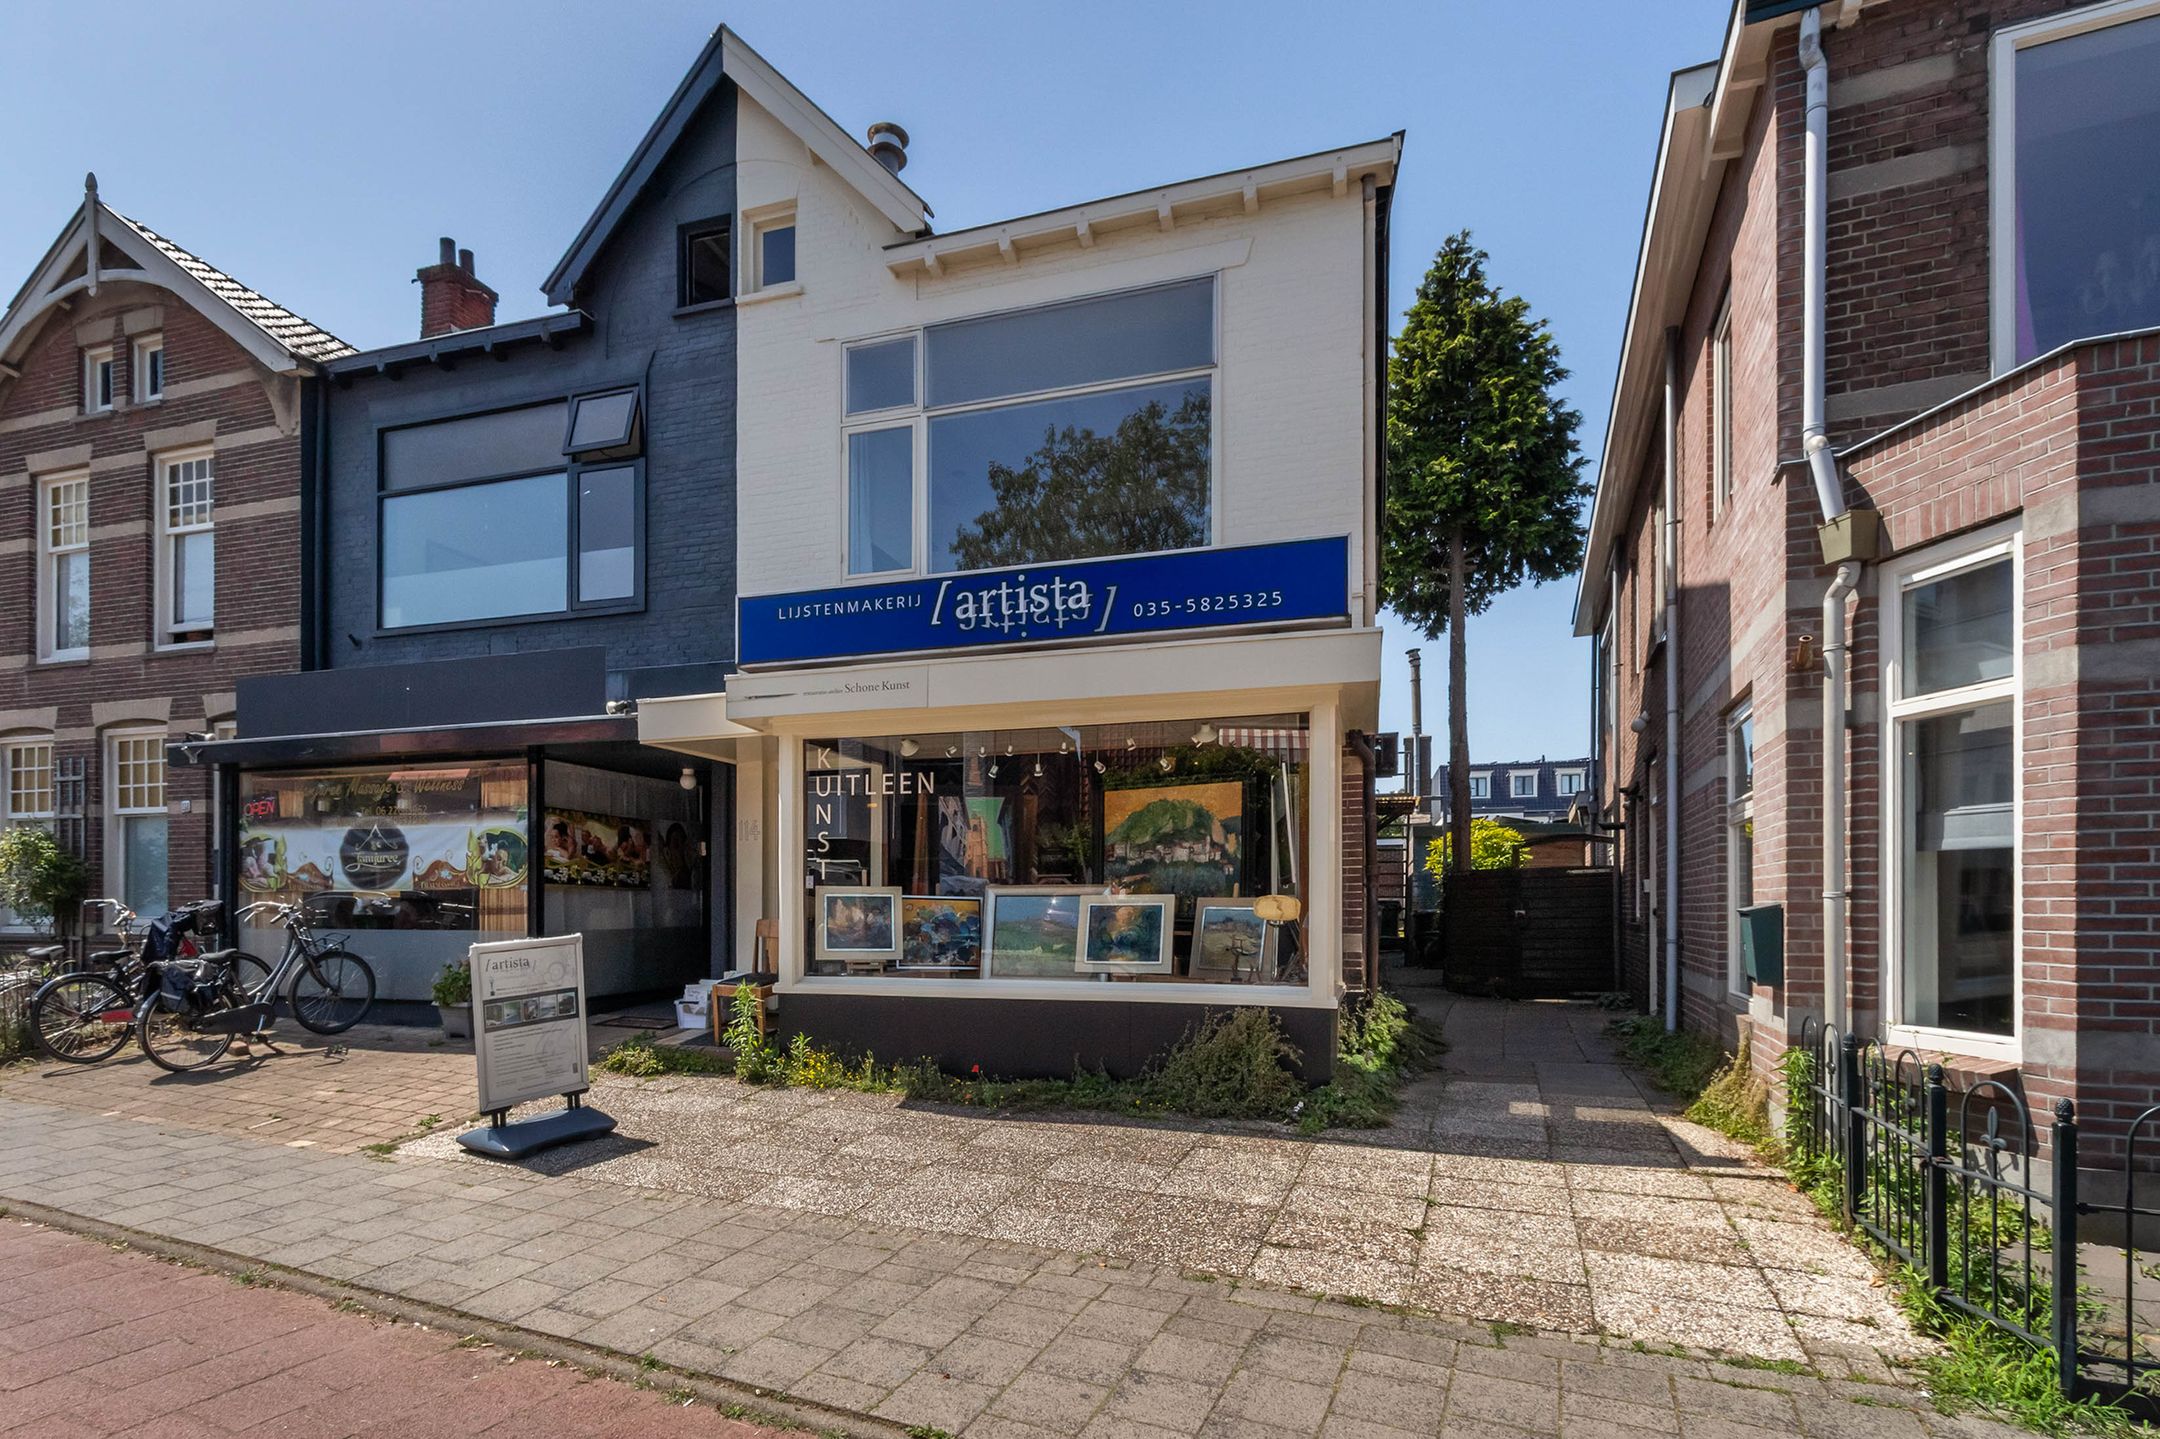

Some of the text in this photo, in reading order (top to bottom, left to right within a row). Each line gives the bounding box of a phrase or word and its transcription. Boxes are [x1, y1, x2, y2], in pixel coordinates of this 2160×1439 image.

[777, 594, 921, 620] LIJSTENMAKERIJ
[1133, 591, 1282, 617] 035-5825325
[844, 682, 880, 694] Schone
[881, 680, 911, 691] Kunst
[815, 772, 935, 797] UITLEEN
[243, 800, 275, 817] OPEN
